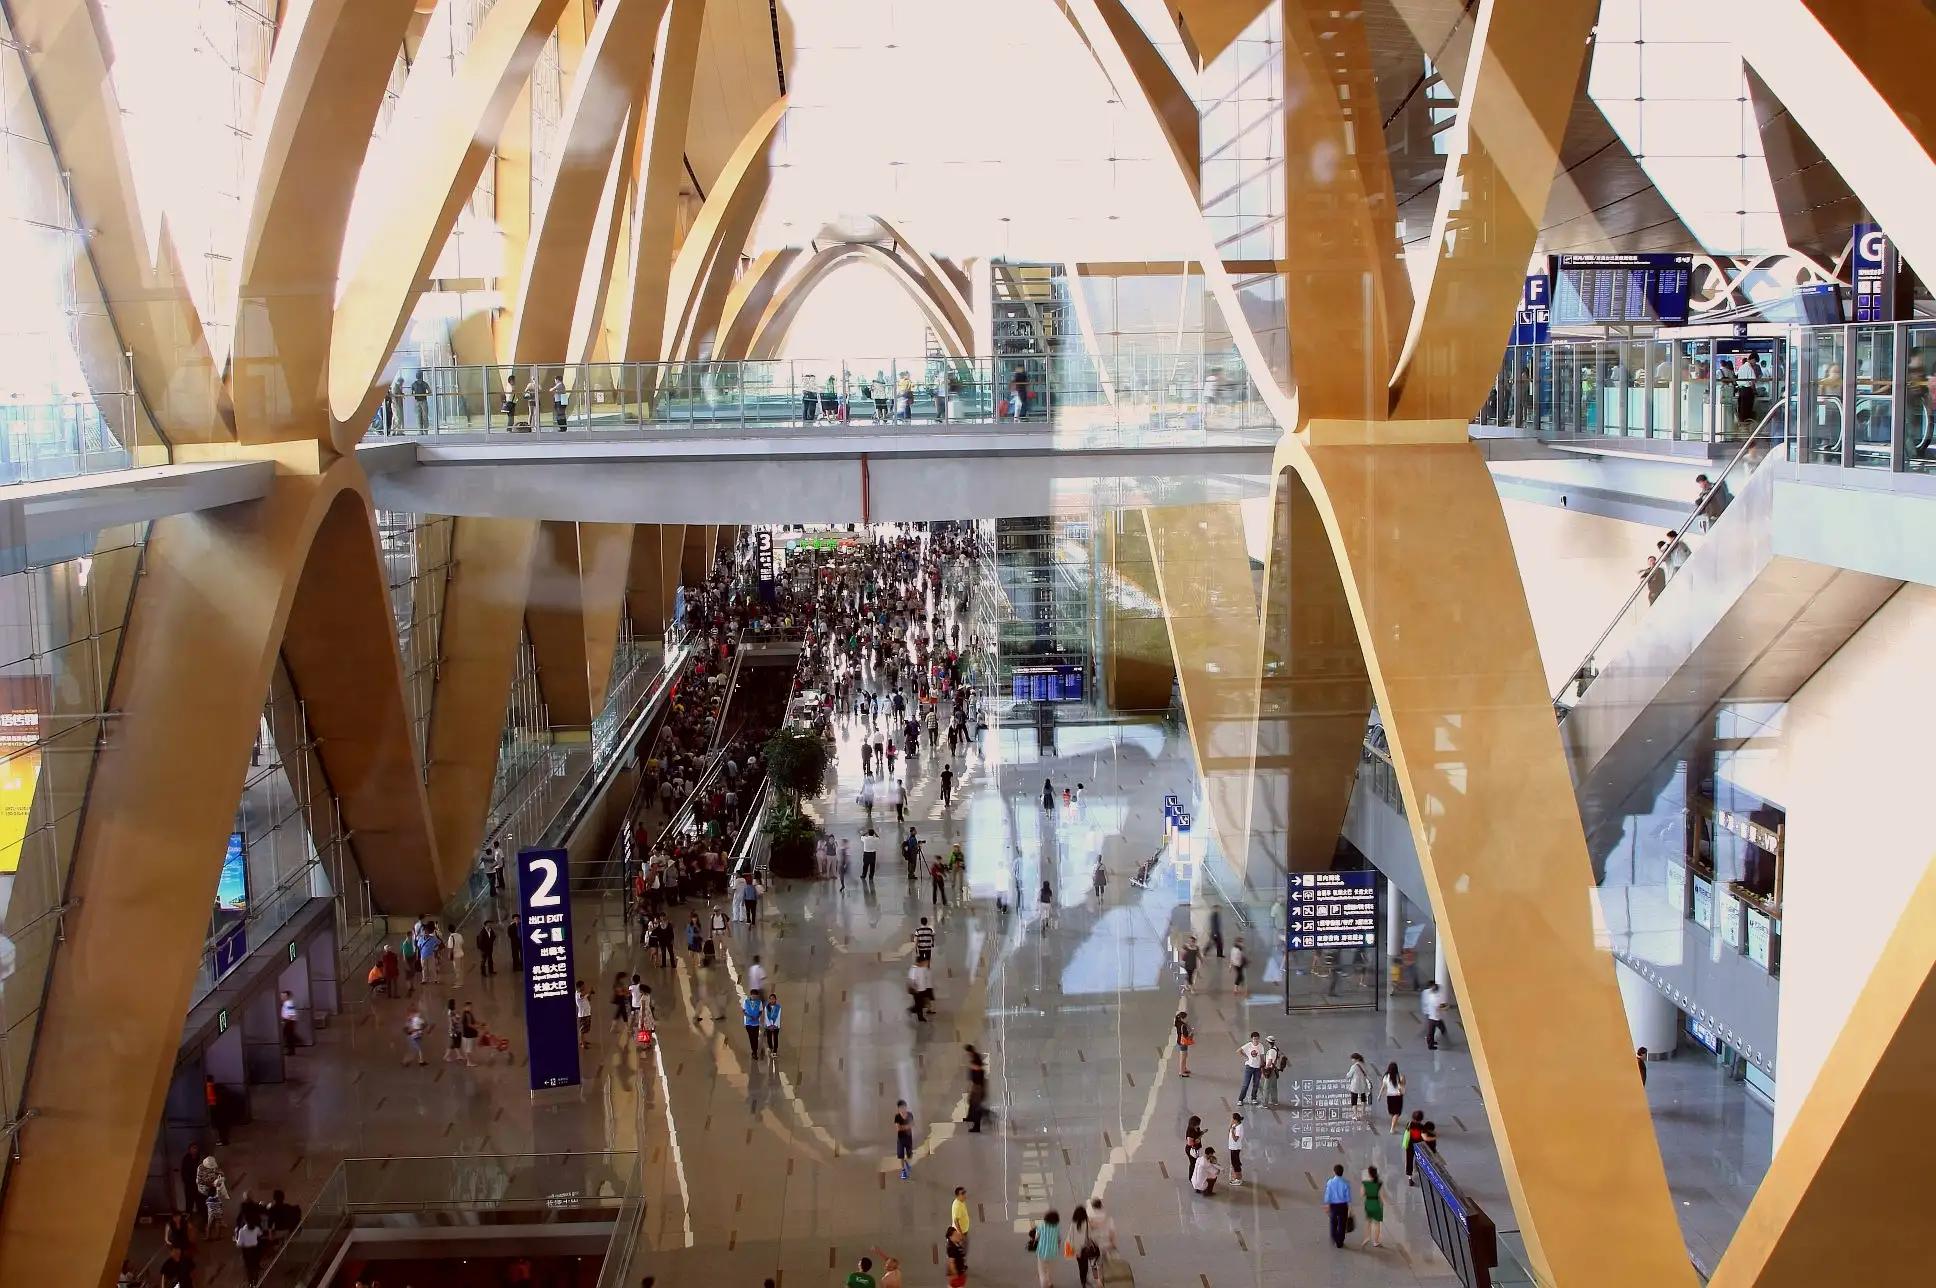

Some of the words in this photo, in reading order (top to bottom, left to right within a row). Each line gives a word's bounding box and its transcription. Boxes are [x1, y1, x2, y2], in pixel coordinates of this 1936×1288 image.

[1860, 231, 1885, 262] G
[1530, 280, 1543, 301] F
[760, 533, 771, 550] 3
[529, 859, 560, 907] 2
[529, 916, 545, 924] 出口
[547, 914, 563, 923] EXIT
[532, 963, 566, 974] 机场大巴
[533, 981, 567, 992] 长途大巴
